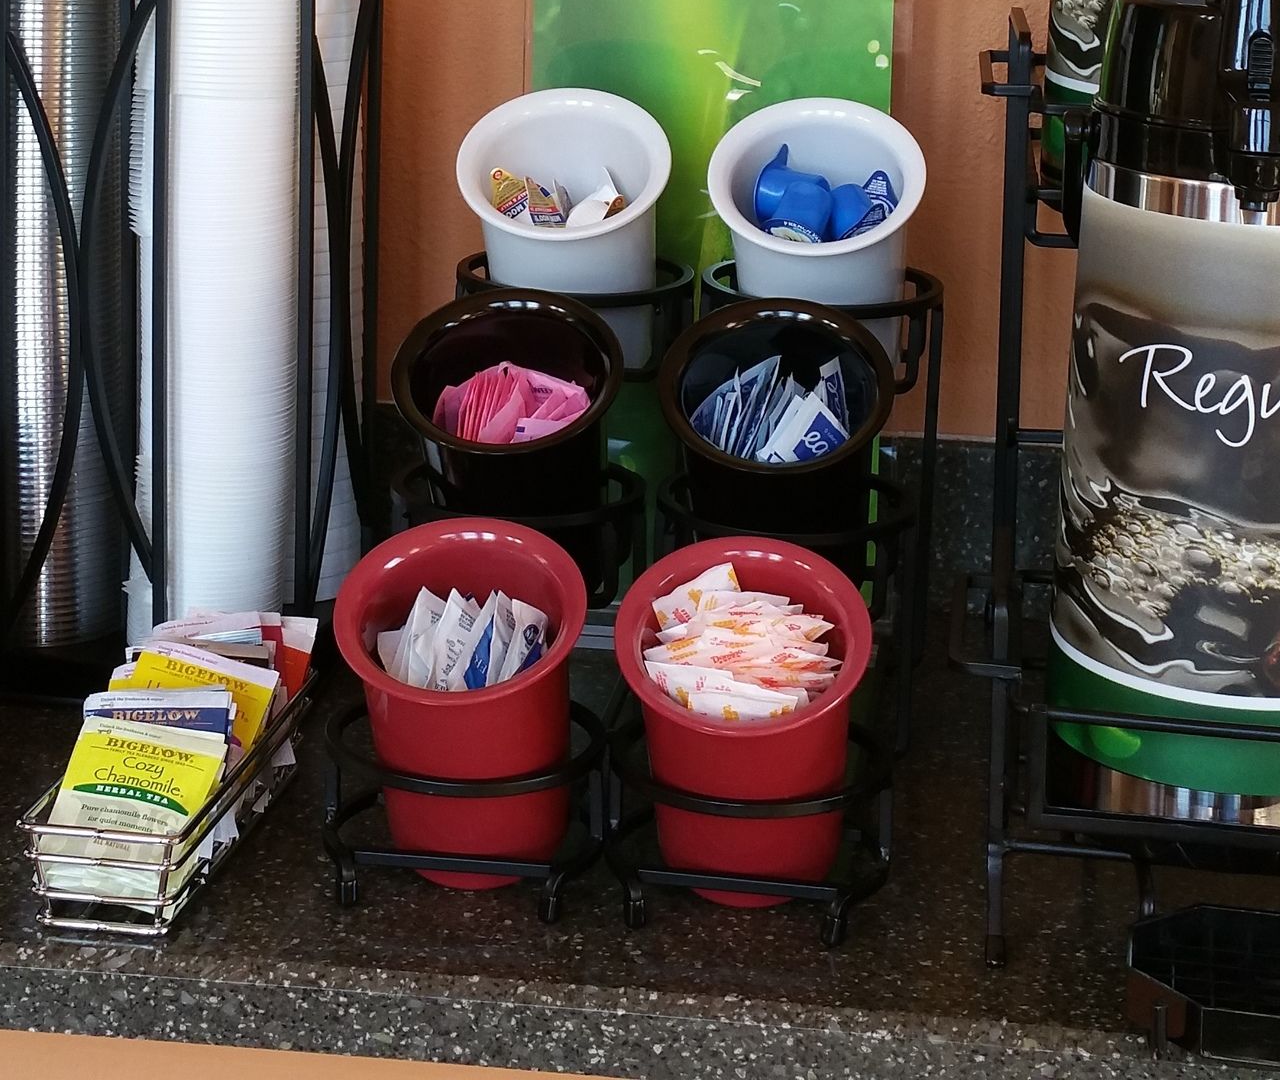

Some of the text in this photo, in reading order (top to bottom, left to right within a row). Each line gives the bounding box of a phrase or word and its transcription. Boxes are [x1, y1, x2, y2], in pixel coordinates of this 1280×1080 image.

[111, 709, 199, 721] BIGELOW
[122, 756, 165, 780] Cozy
[95, 784, 169, 805] HERBAL TEA
[80, 803, 169, 827] Pure chamomile flowers
[99, 817, 118, 826] quiet
[118, 821, 154, 834] moments
